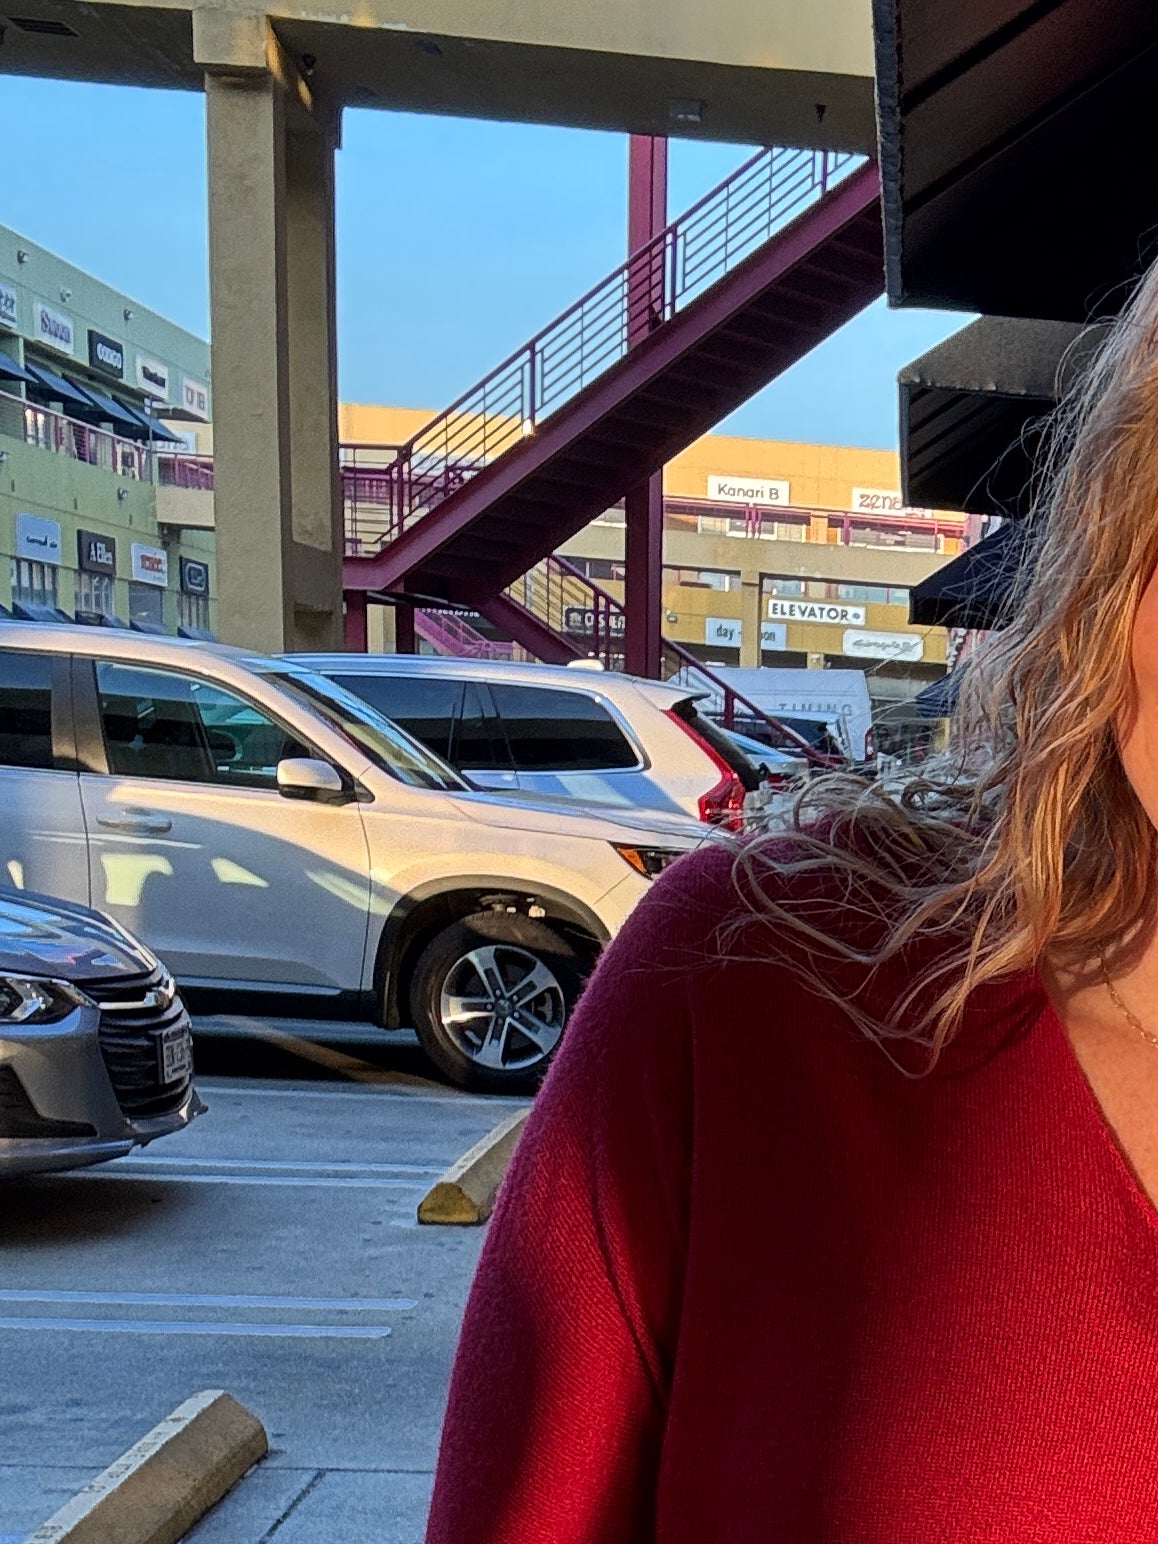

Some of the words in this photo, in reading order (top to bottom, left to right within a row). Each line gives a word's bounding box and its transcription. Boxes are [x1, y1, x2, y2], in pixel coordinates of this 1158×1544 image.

[717, 483, 764, 498] Kanari
[769, 488, 779, 500] B
[772, 602, 849, 621] ELEVATOR
[716, 624, 735, 640] day
